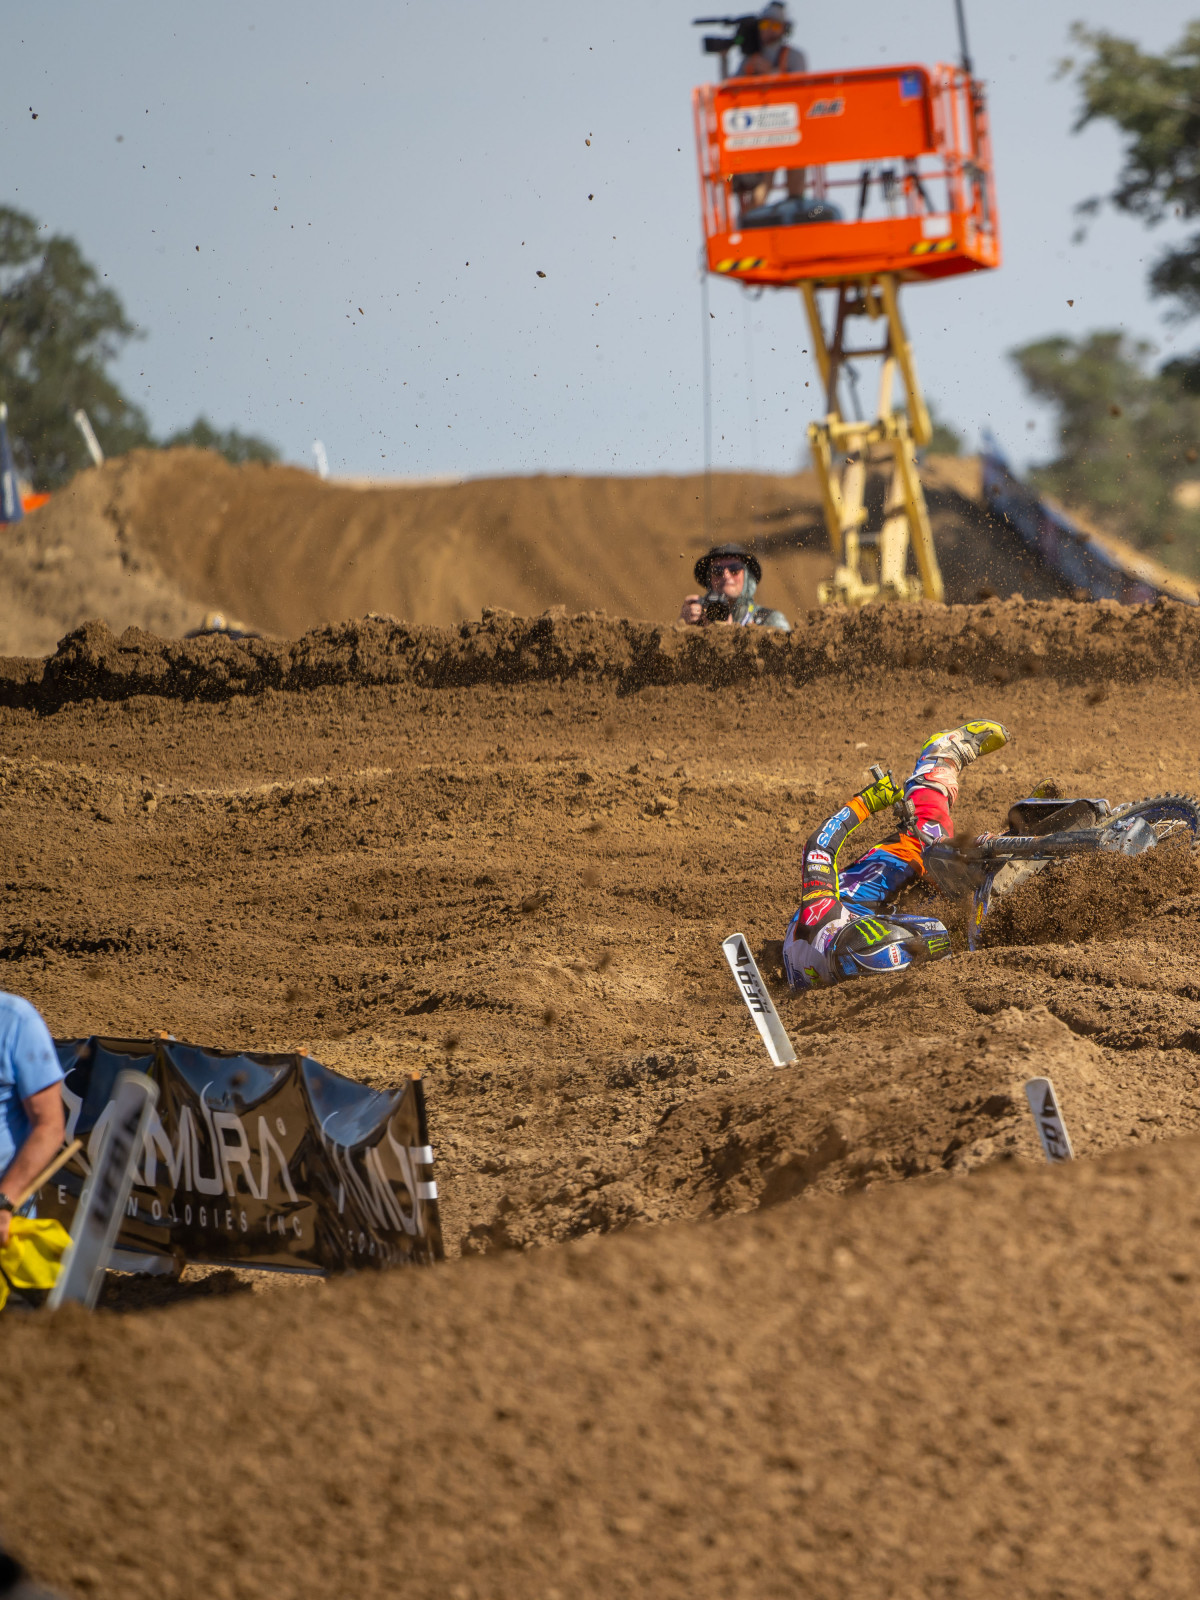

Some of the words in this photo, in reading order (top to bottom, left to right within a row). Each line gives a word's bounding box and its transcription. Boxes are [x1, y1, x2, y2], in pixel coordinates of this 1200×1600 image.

[737, 971, 765, 1013] UFO
[1041, 1122, 1065, 1160] FO
[266, 1213, 302, 1237] INC
